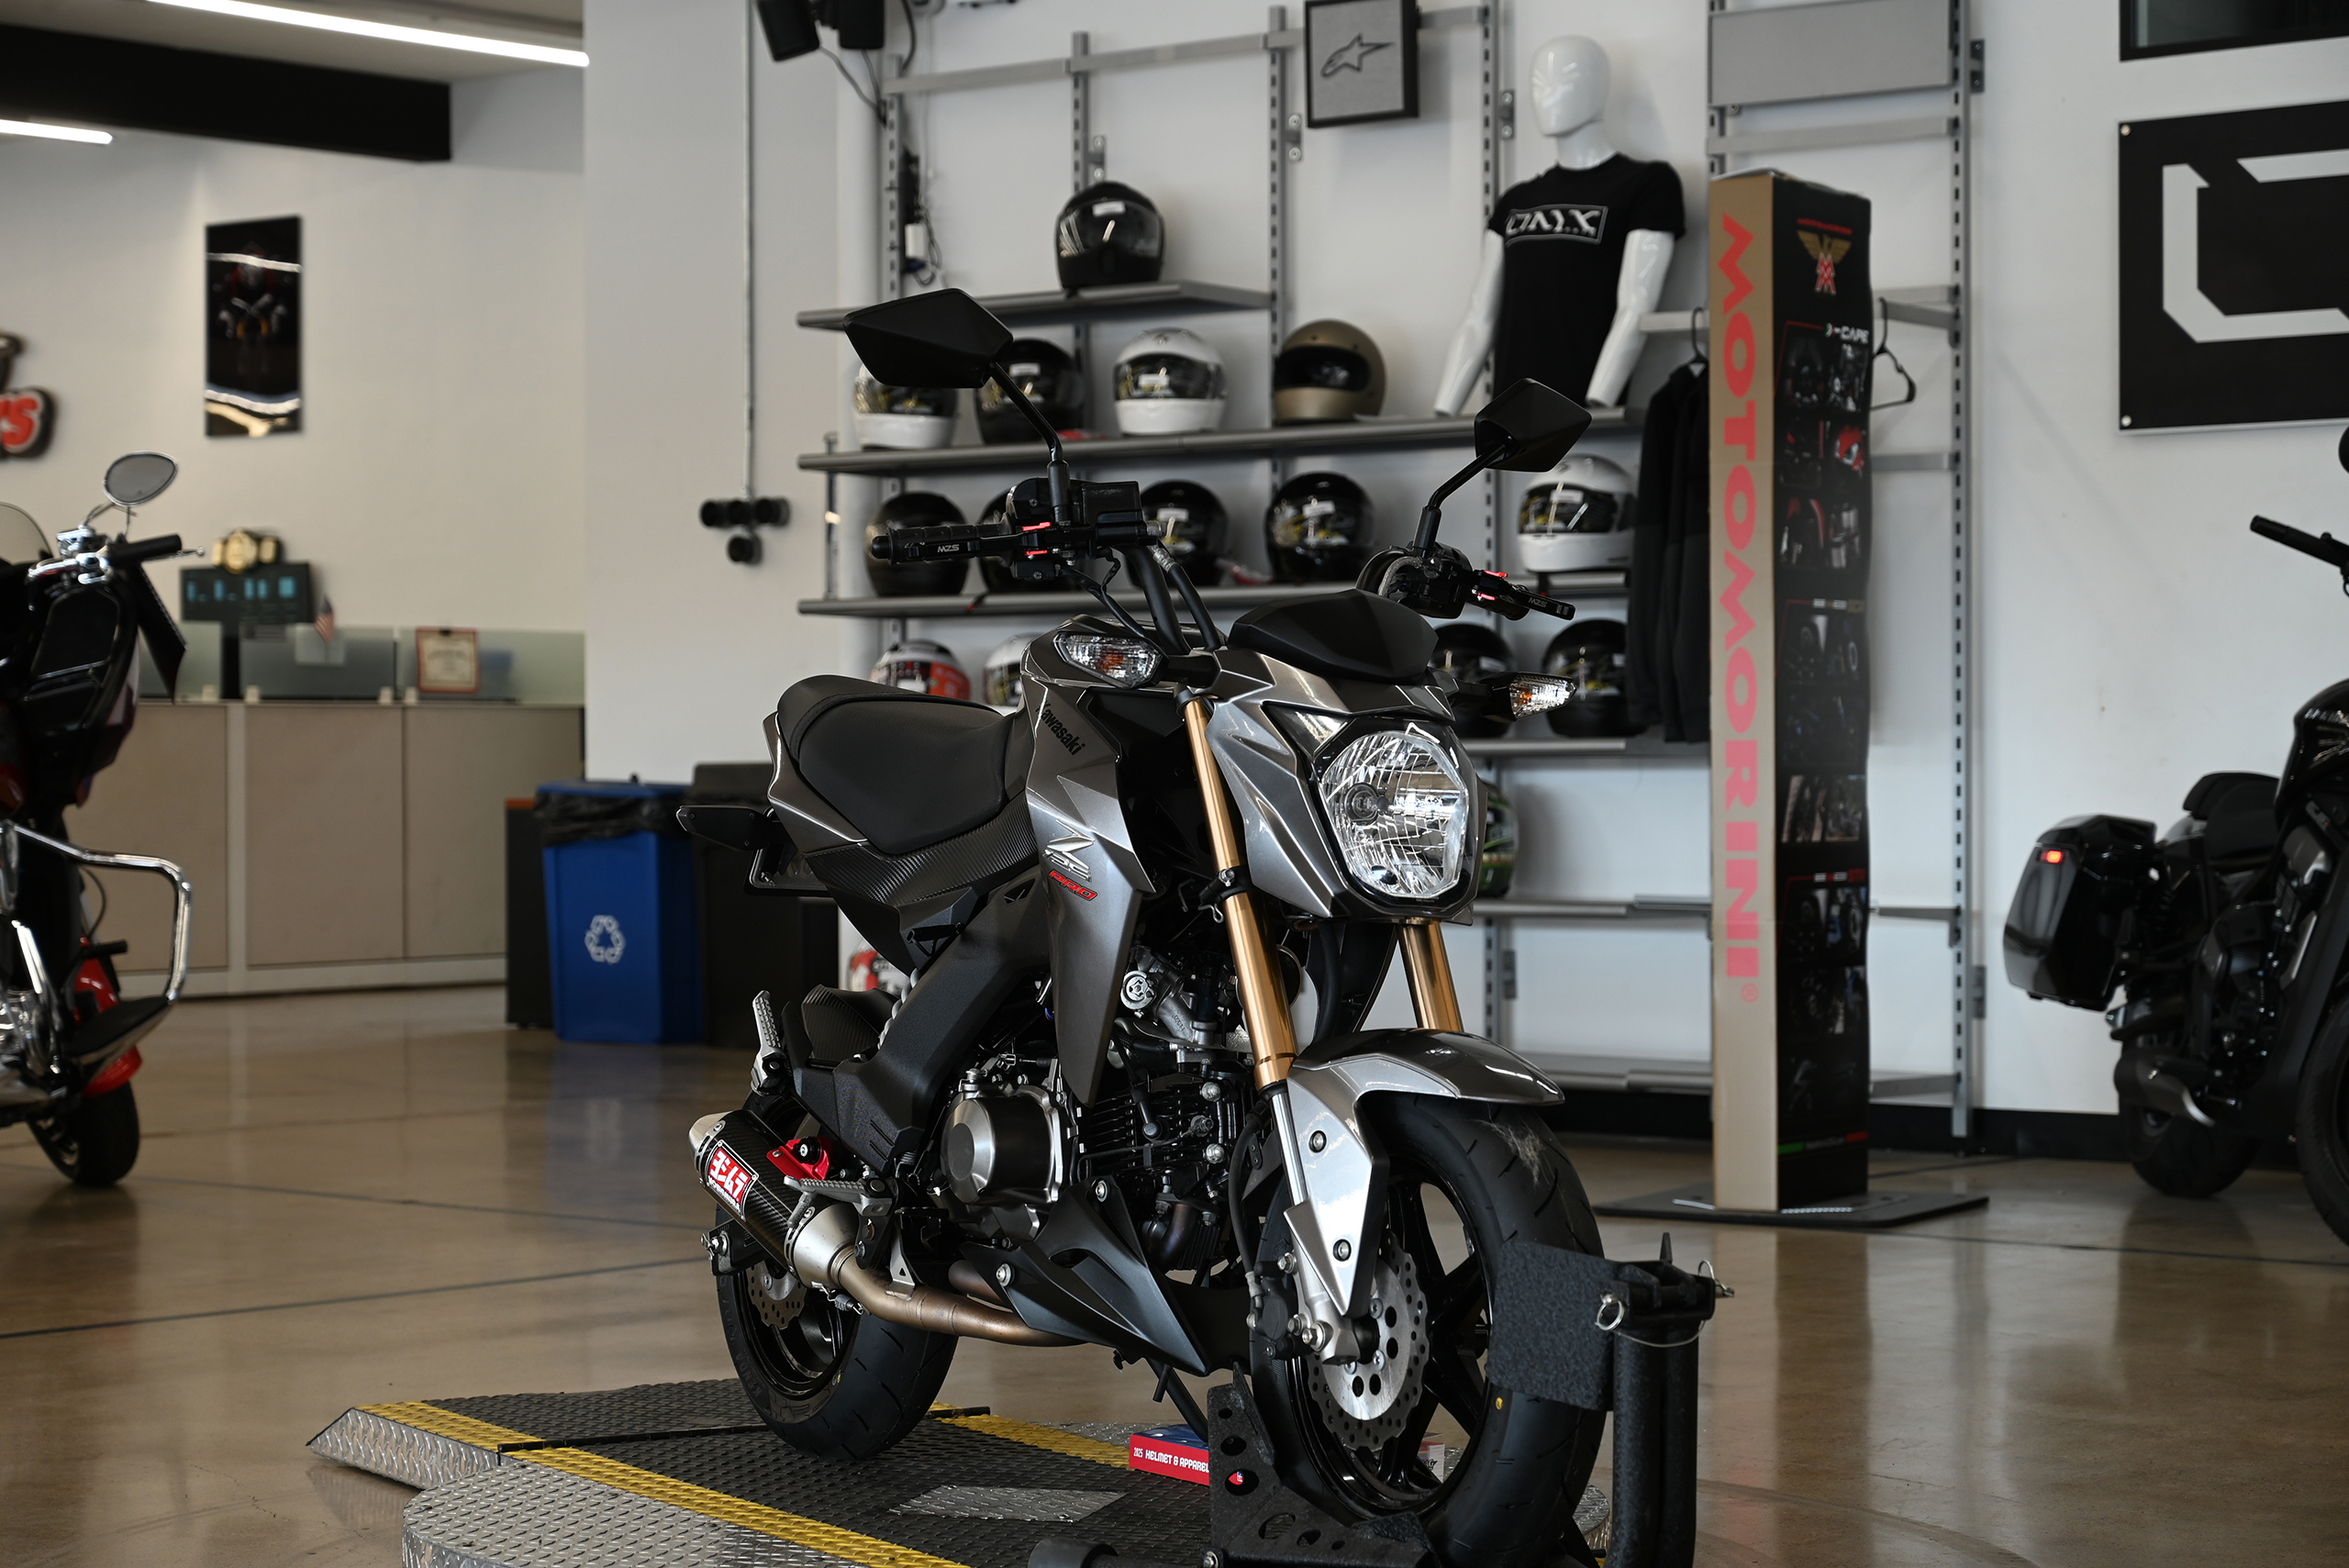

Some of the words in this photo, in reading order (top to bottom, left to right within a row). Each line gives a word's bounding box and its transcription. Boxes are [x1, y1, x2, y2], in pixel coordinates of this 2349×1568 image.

[1049, 869, 1098, 901] PRO
[1133, 1447, 1143, 1458] 2025
[1145, 1450, 1173, 1465] HELMET
[1173, 1455, 1179, 1466] &
[1179, 1457, 1209, 1473] APPAREL
